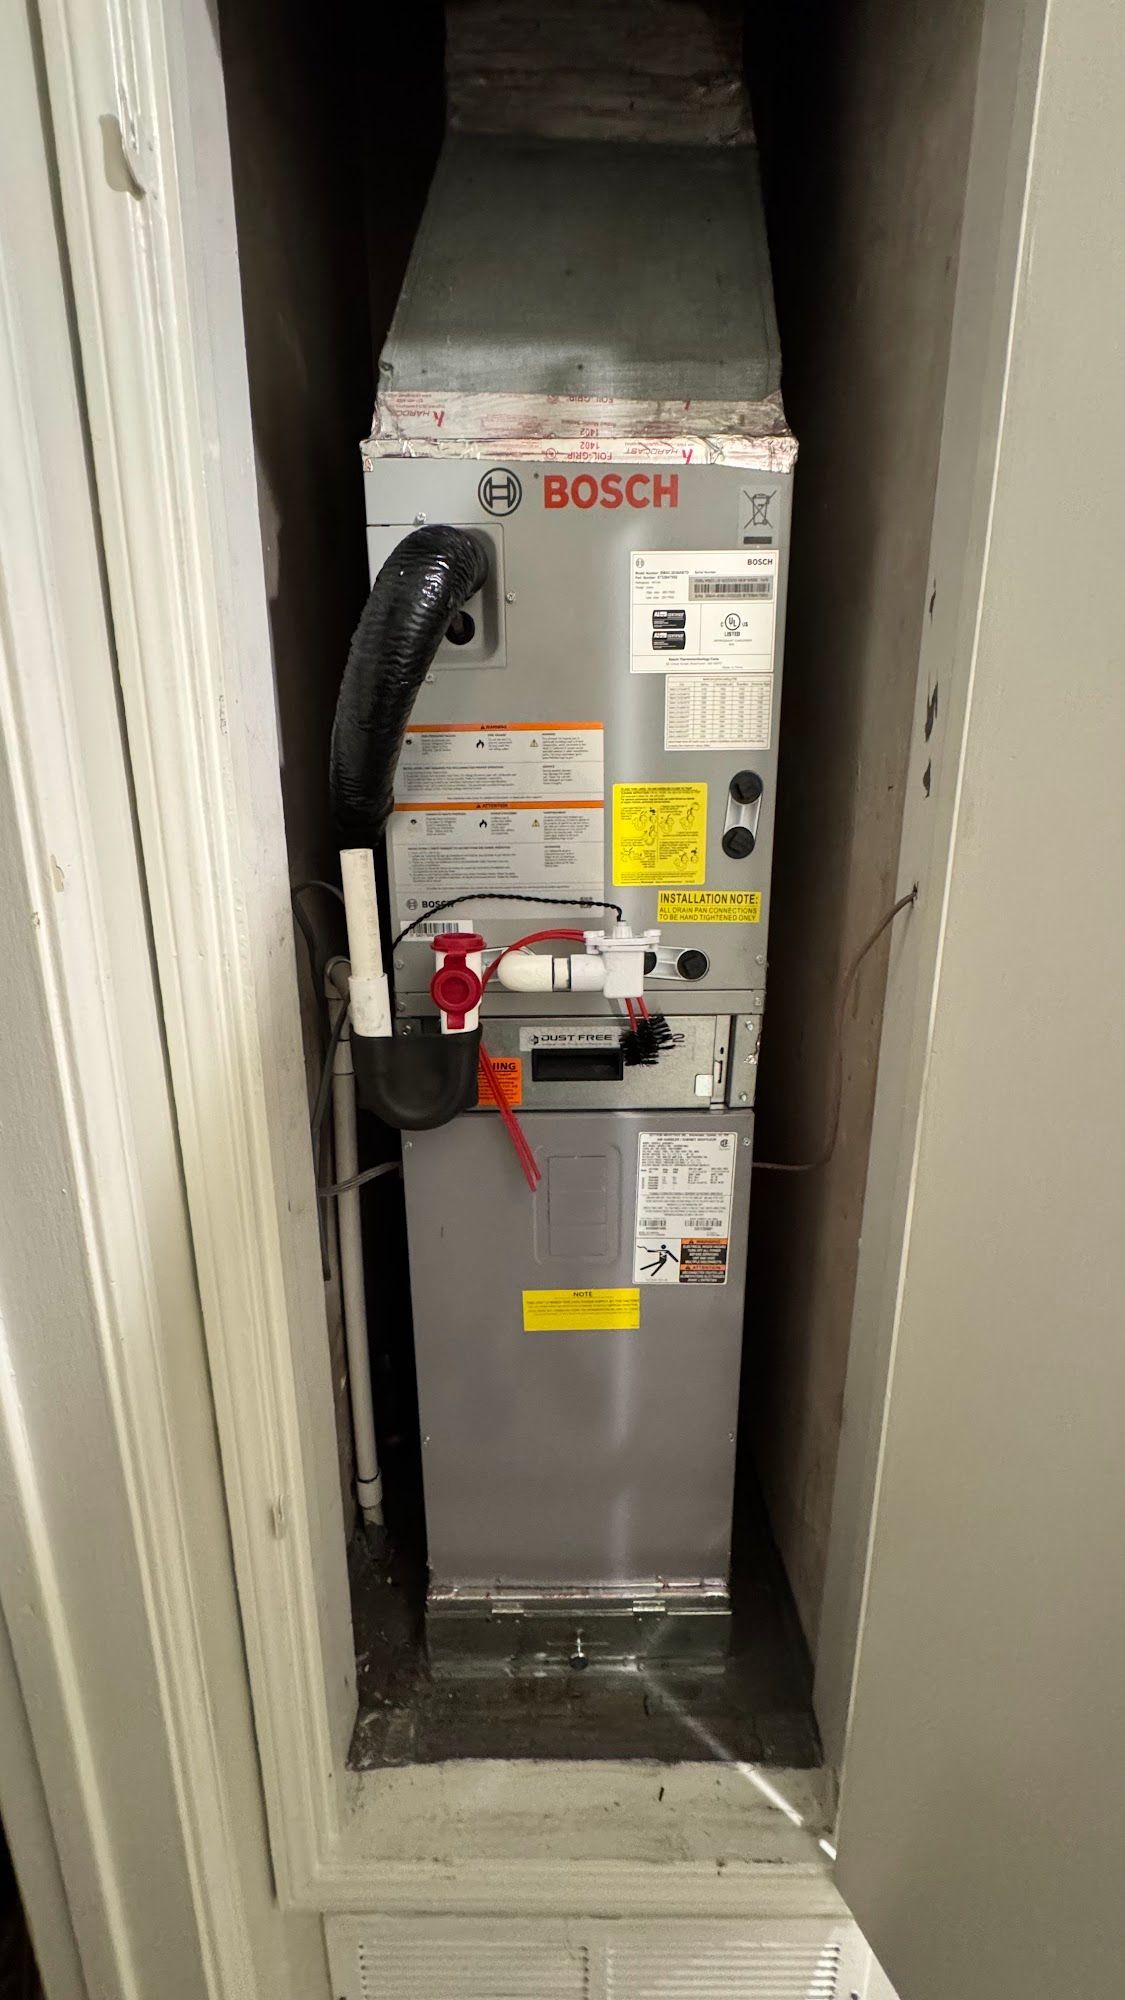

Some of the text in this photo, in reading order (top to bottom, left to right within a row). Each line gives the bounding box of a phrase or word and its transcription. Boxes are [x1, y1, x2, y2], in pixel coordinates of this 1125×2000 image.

[580, 441, 600, 449] 1402
[567, 451, 613, 460] FOIL-GRIP
[544, 474, 679, 509] BOSCH
[747, 558, 773, 566] BOSCH
[728, 617, 737, 627] UL
[660, 893, 759, 905] INSTALLATION NOTE:
